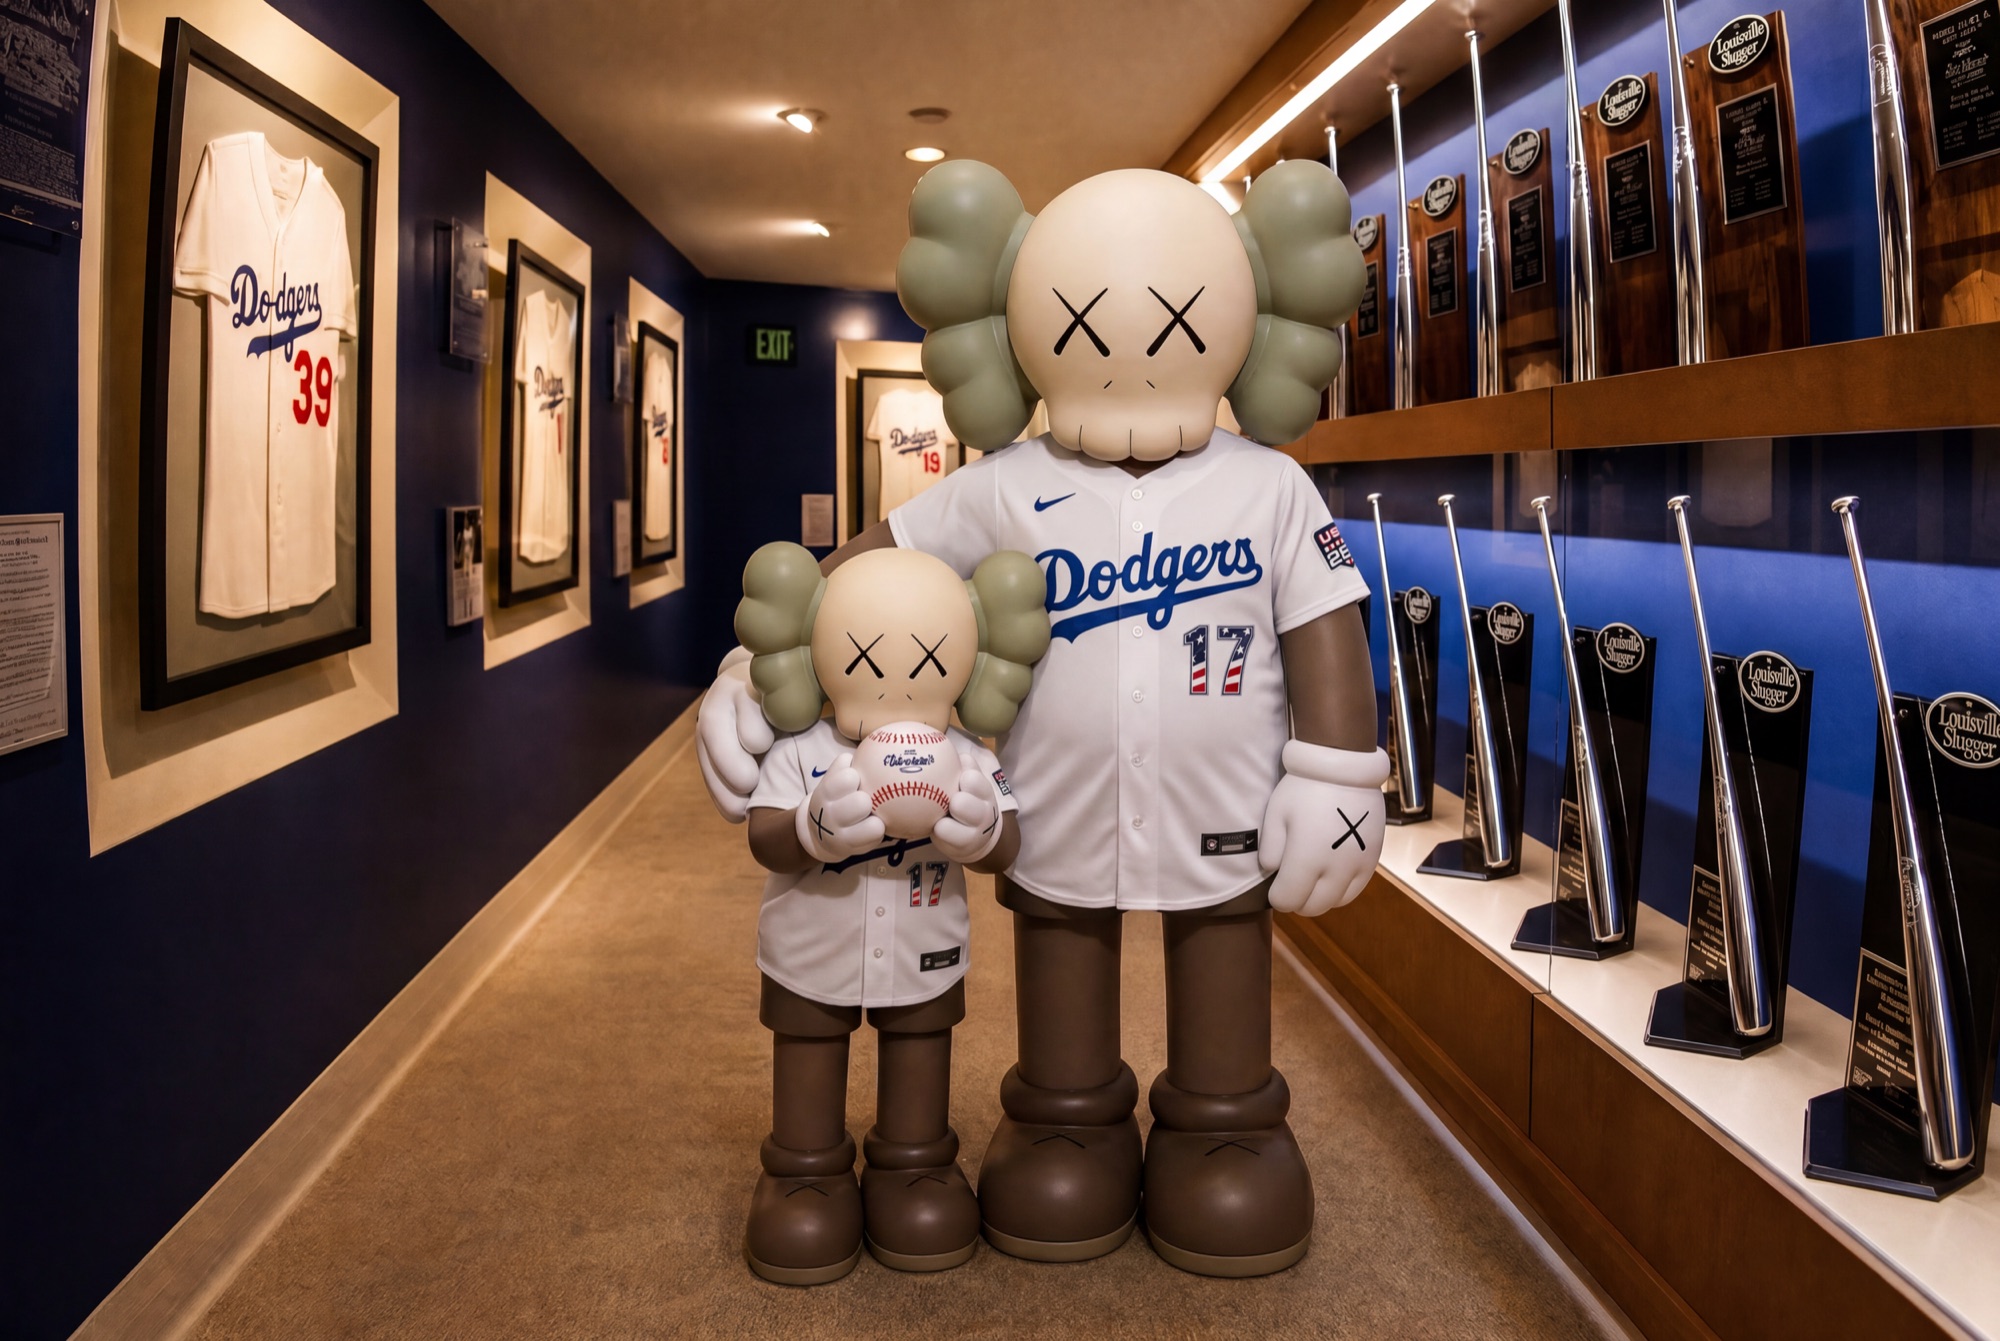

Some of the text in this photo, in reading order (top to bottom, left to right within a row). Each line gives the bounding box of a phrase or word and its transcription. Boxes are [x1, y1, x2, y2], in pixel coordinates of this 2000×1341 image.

[1716, 21, 1765, 55] Louisville
[1721, 41, 1759, 68] Slugger
[1604, 80, 1642, 109] Louisville
[1607, 98, 1638, 121] Slugger
[231, 264, 322, 363] Dodgers
[756, 328, 791, 360] EXIT
[293, 350, 332, 427] 39
[890, 427, 938, 457] Dodgers
[923, 452, 941, 474] 19
[1036, 531, 1263, 632] Dodgers
[1604, 631, 1640, 652] Louisville
[1183, 624, 1255, 696] 17
[1606, 646, 1636, 668] Slugger
[1747, 661, 1795, 688] Louisville
[1750, 680, 1788, 707] Slugger
[1943, 727, 1997, 761] Slugger
[906, 861, 949, 907] 17
